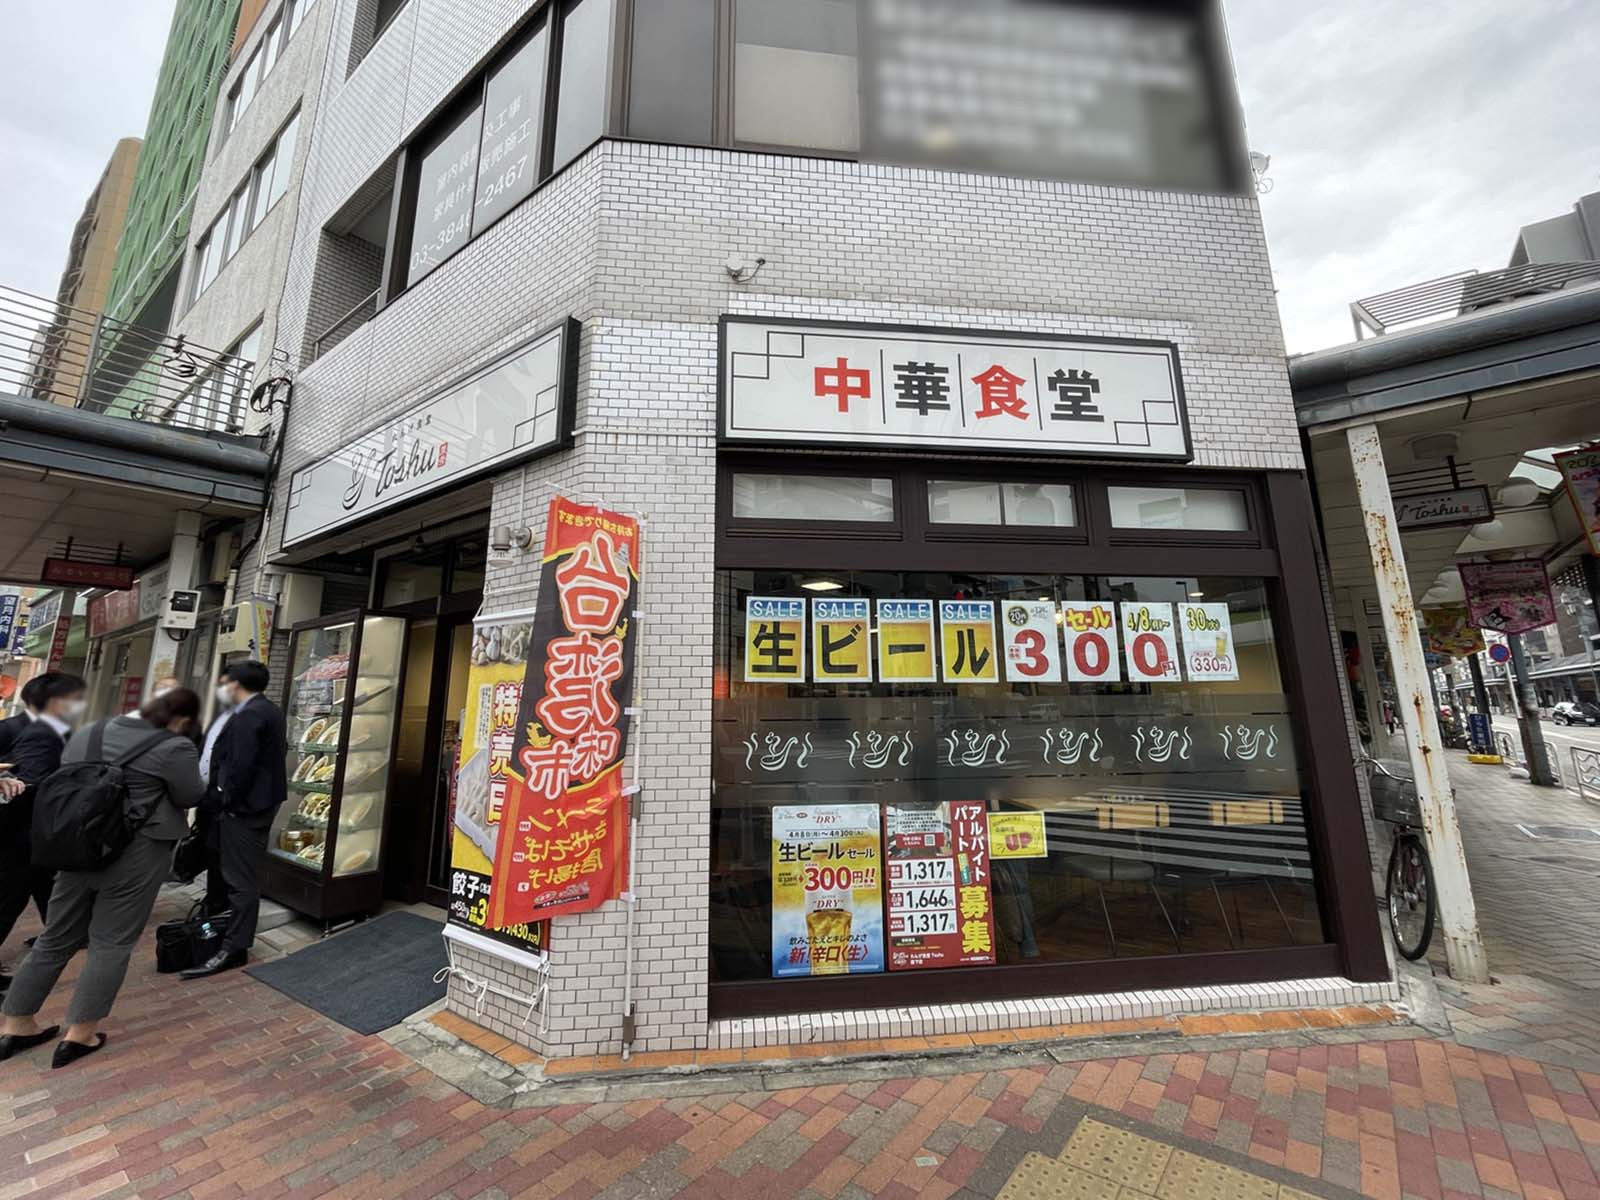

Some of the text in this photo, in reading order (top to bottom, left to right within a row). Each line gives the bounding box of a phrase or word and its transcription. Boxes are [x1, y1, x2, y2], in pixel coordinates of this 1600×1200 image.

[813, 356, 1106, 423] 中華食堂
[375, 438, 437, 498] Toshu
[1409, 503, 1461, 520] Toshu
[753, 602, 988, 619] SALE SALE SALE SALE
[1067, 606, 1110, 632] セール
[752, 621, 990, 676] 生ビール
[954, 805, 970, 852] パート
[968, 806, 986, 882] アルバイト
[959, 885, 992, 954] 募集
